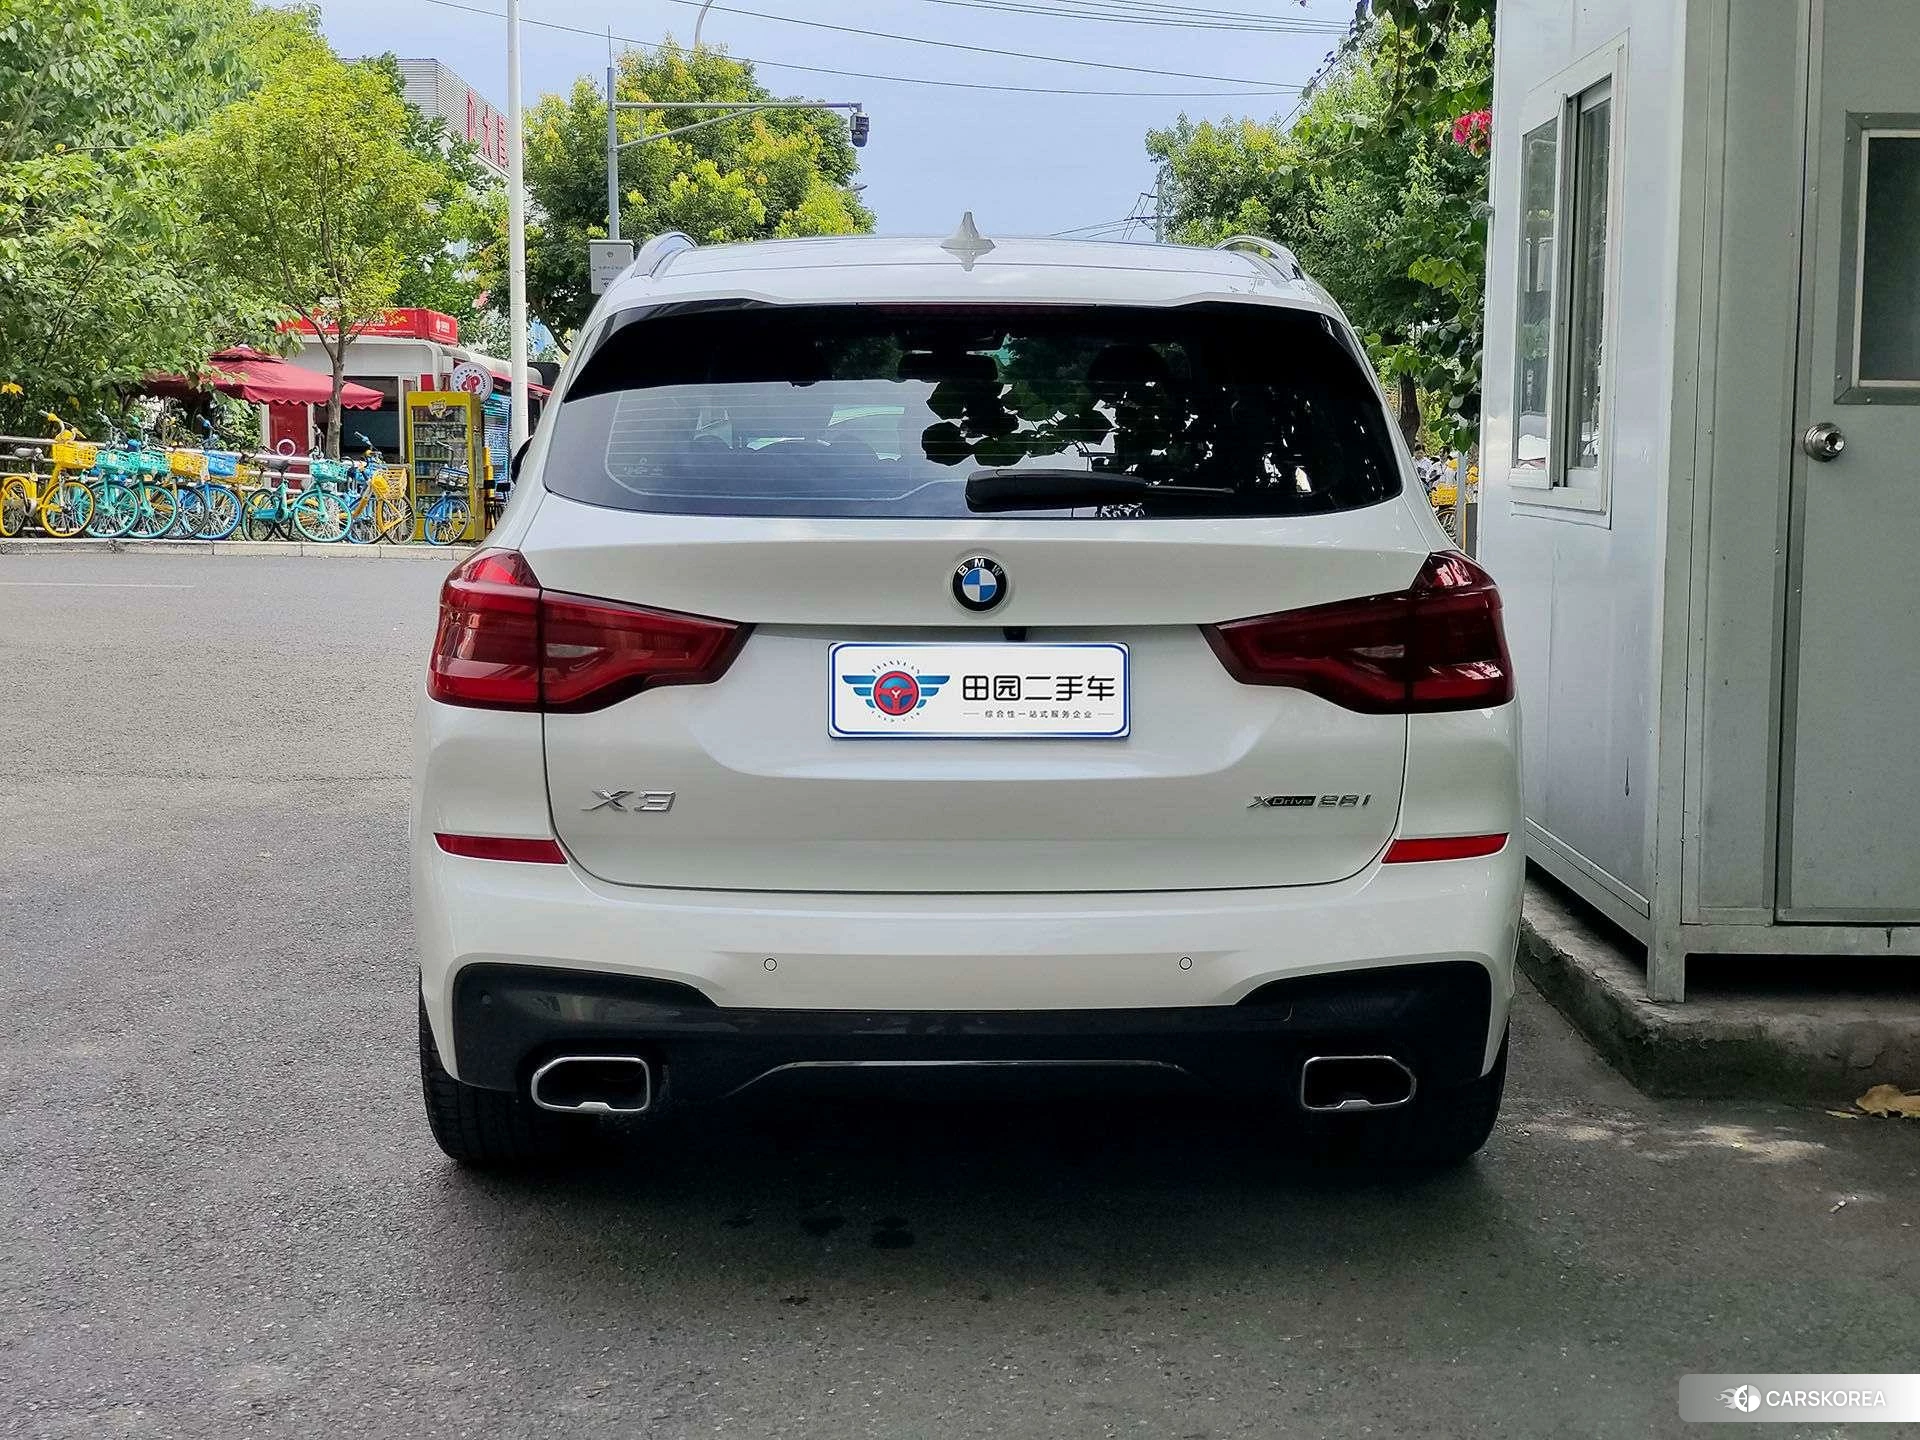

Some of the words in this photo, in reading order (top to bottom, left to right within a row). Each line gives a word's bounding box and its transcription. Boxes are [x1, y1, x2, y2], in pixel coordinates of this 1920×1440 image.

[957, 558, 1002, 577] BMW
[962, 675, 1116, 702] 田园二手车
[580, 790, 677, 812] X3
